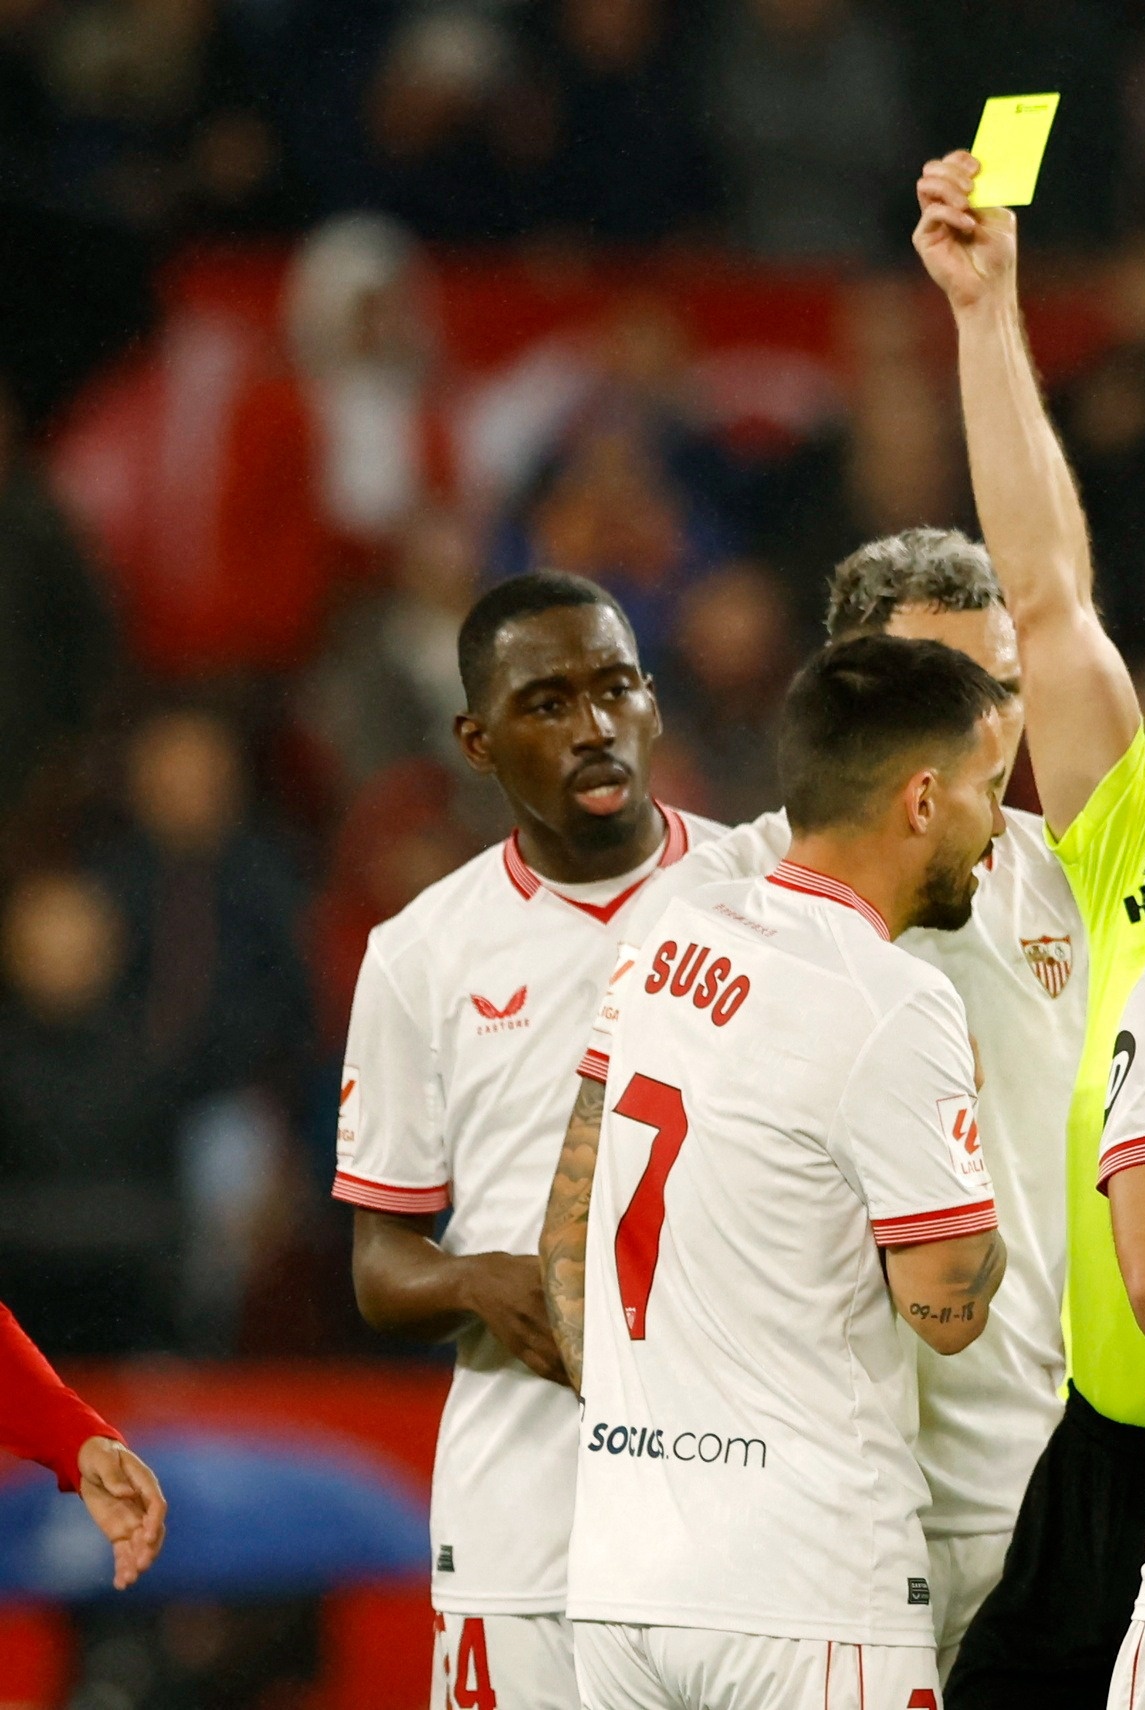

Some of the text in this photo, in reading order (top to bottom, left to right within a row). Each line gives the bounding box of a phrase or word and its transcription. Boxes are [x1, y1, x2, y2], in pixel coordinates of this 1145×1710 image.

[645, 939, 752, 1028] SUSO
[476, 1018, 530, 1036] CASTORE
[598, 1005, 620, 1021] IGA
[611, 1073, 689, 1341] 7
